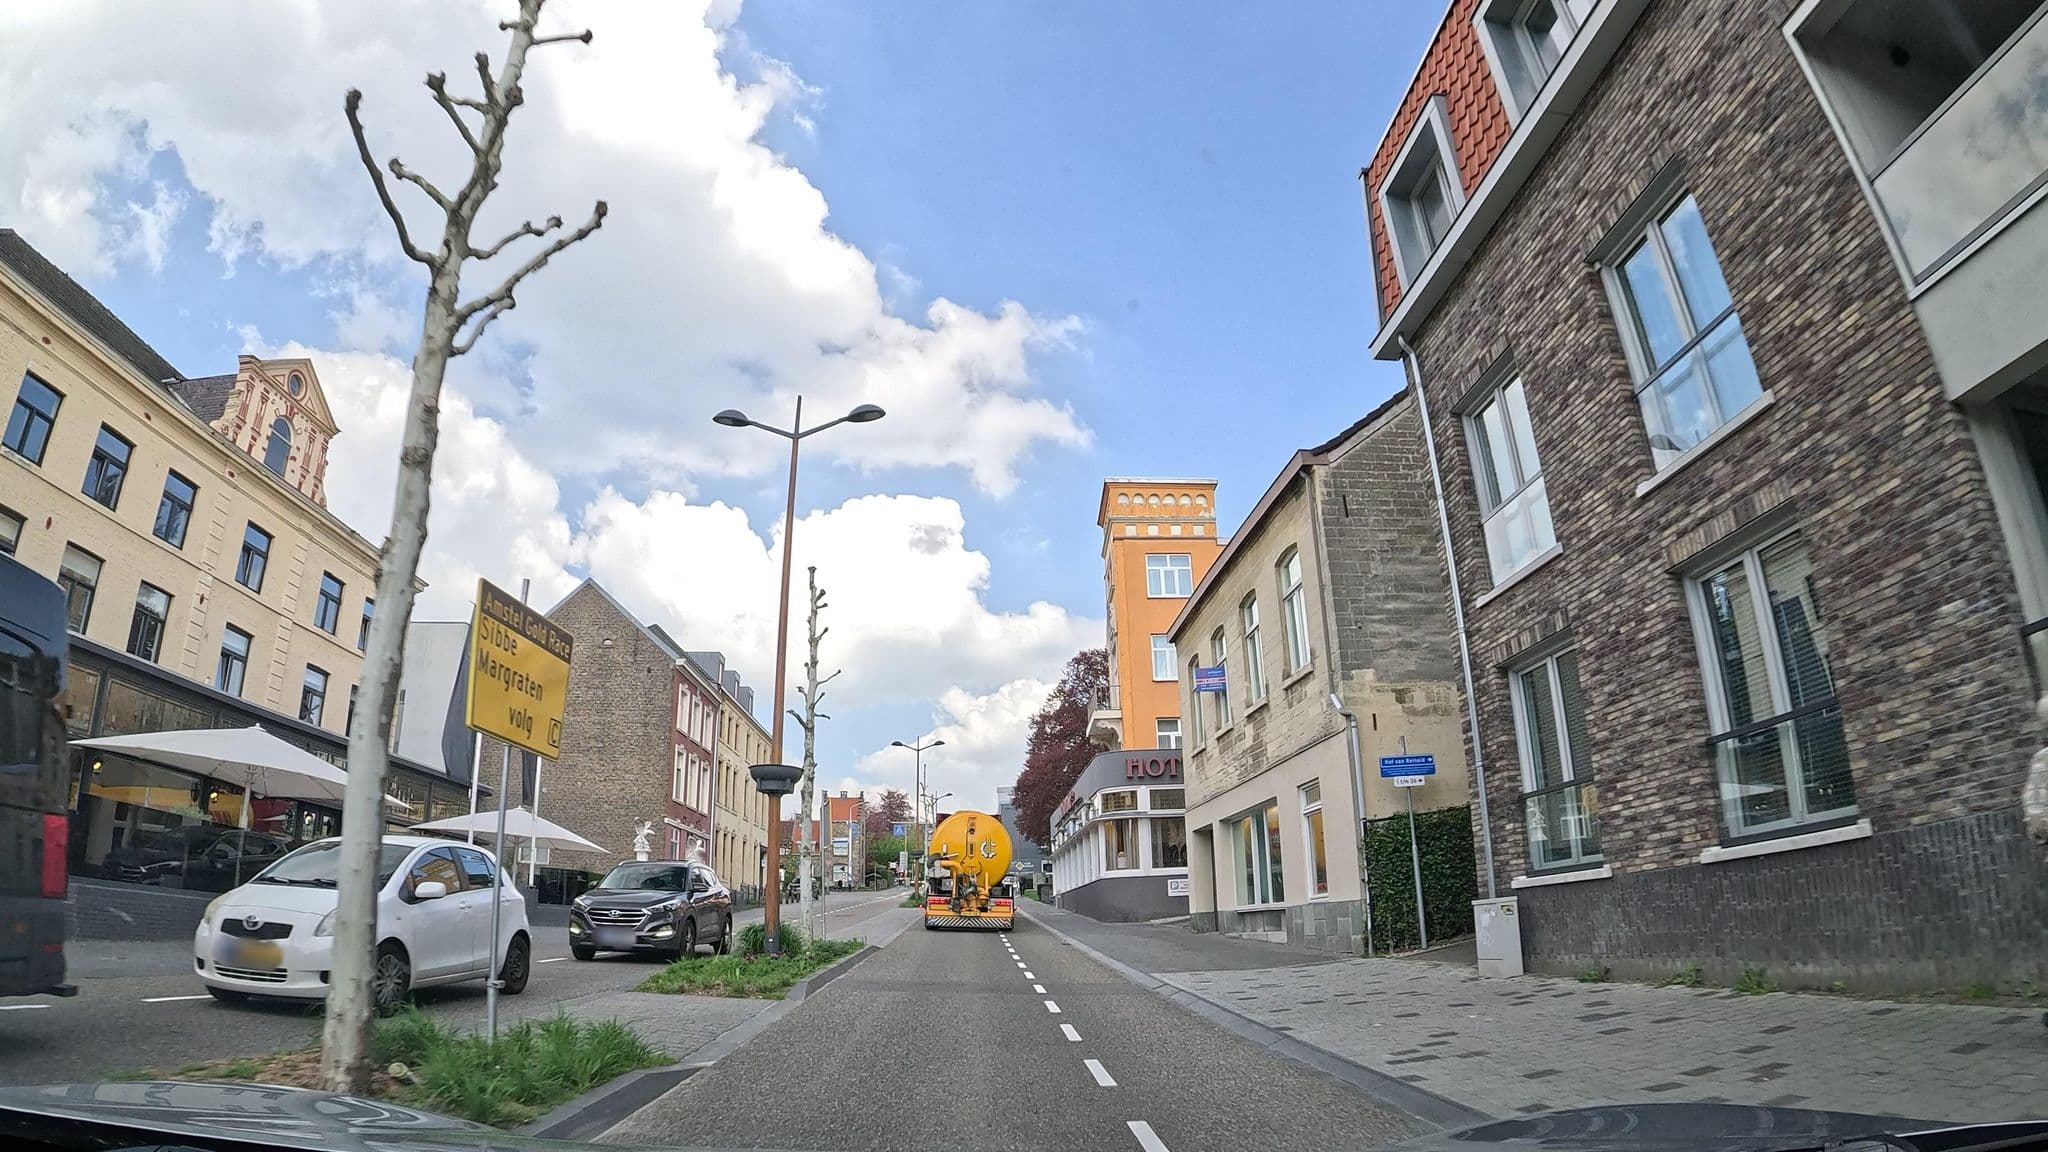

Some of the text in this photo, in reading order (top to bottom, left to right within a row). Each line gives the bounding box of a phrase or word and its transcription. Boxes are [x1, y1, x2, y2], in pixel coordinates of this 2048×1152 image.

[480, 615, 518, 656] Sibbe
[483, 591, 571, 659] Amstel Gold Race
[478, 647, 544, 702] Margraten
[508, 706, 534, 741] volg
